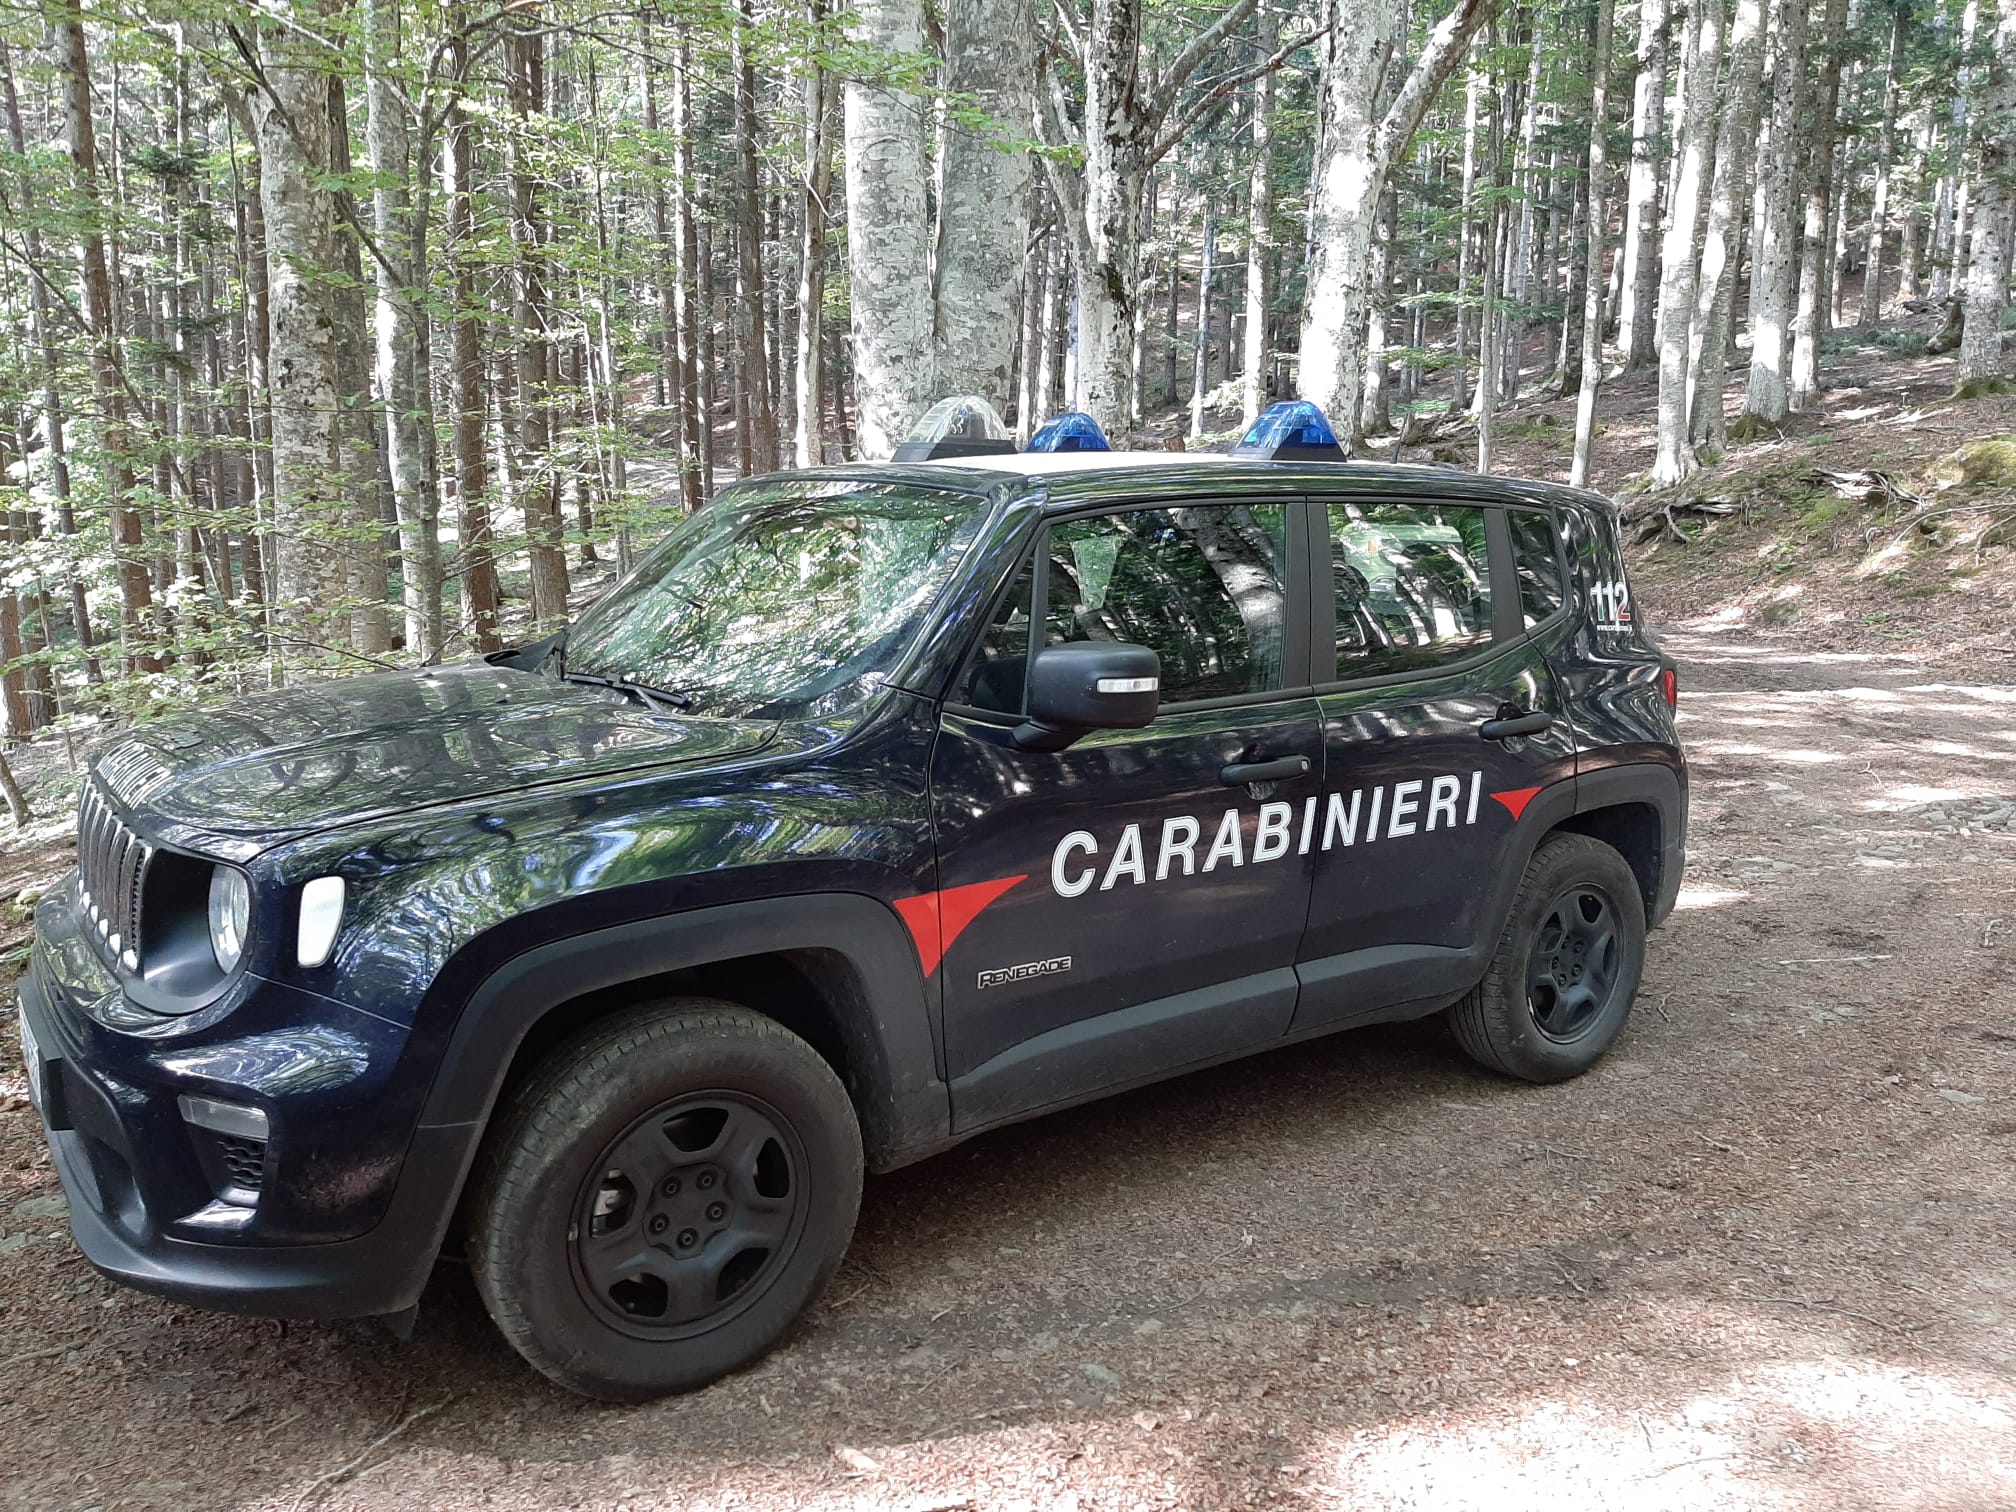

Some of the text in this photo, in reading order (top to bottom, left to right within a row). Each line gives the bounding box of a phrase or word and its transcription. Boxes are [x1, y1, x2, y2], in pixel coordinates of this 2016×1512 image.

[1590, 581, 1630, 621] 112
[1050, 770, 1483, 898] CARABINIERI
[977, 956, 1072, 989] RENEGADE
